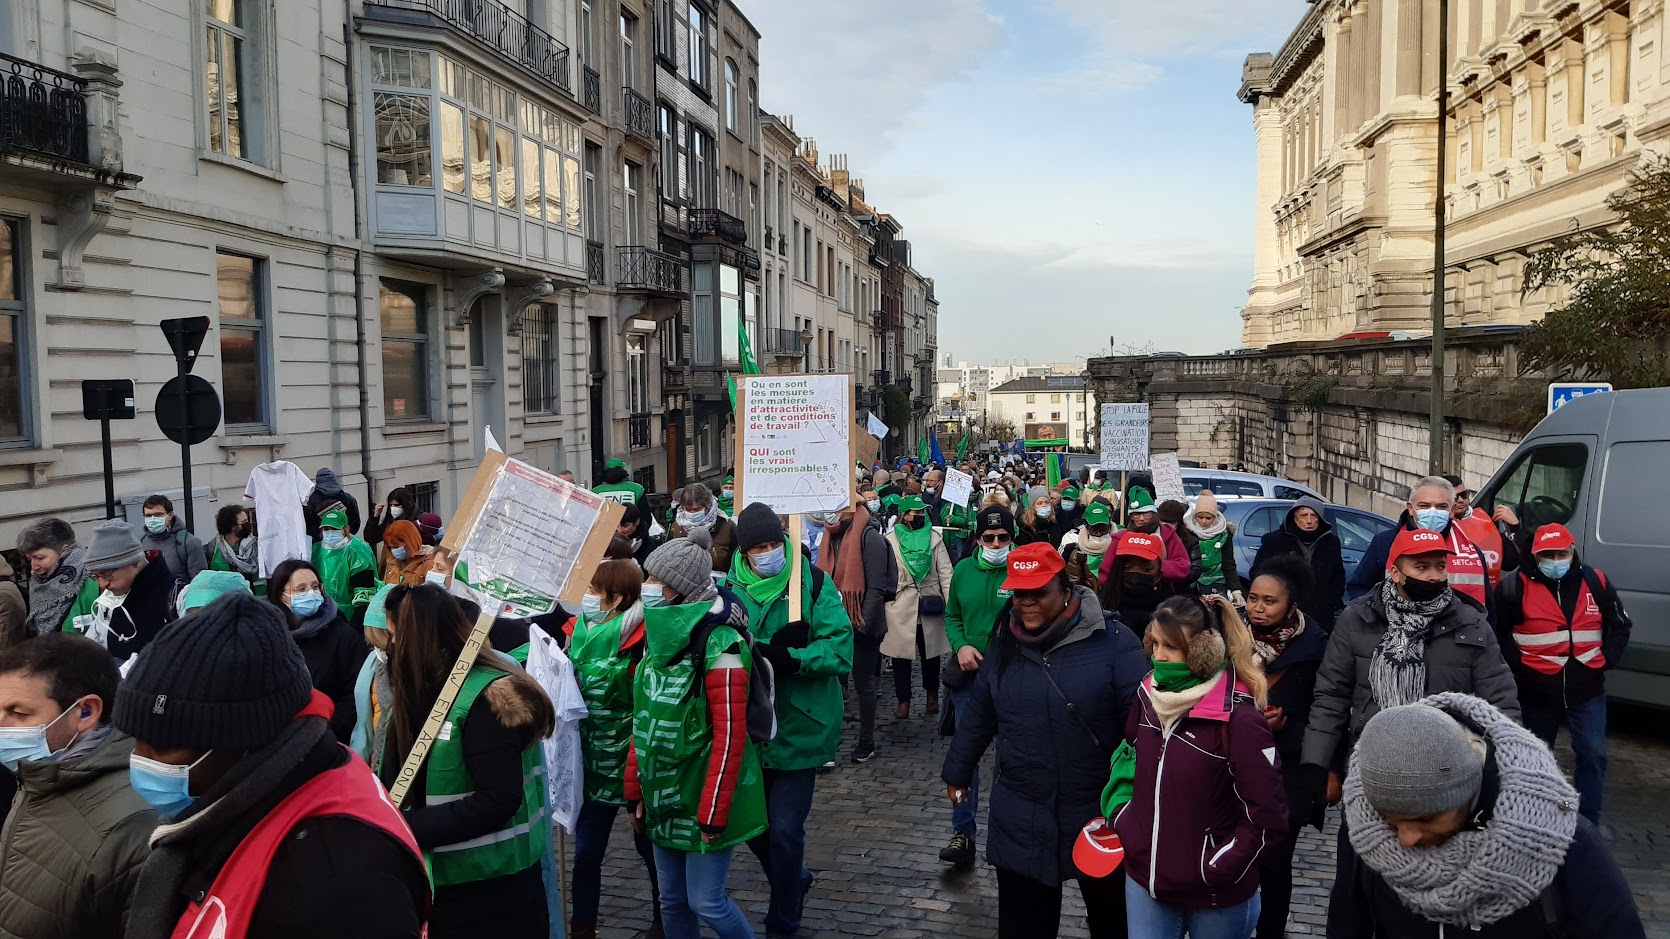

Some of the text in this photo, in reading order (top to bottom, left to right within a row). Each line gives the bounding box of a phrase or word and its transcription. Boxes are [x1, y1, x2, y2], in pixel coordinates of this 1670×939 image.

[751, 381, 764, 389] Où
[784, 380, 808, 389] sont
[751, 389, 815, 397] les mesures
[767, 396, 808, 405] matière
[750, 404, 819, 413] d'attractivité
[1102, 405, 1119, 416] STOP
[750, 412, 836, 422] et de conditions
[750, 420, 809, 430] de travail ?
[1115, 419, 1149, 427] GRANDEURS
[1104, 429, 1146, 437] VACCINATION
[1104, 438, 1145, 446] OBLIGATOIRE
[750, 447, 796, 457] QUI sont
[750, 457, 795, 465] les vrais
[750, 463, 838, 475] irresponsables ?
[1128, 537, 1152, 545] CGSP
[1413, 533, 1439, 541] CGSP
[1013, 561, 1039, 570] CGSP
[466, 628, 486, 651] LE
[450, 659, 470, 689] BW
[430, 698, 450, 723] EN
[396, 730, 433, 793] ACTION
